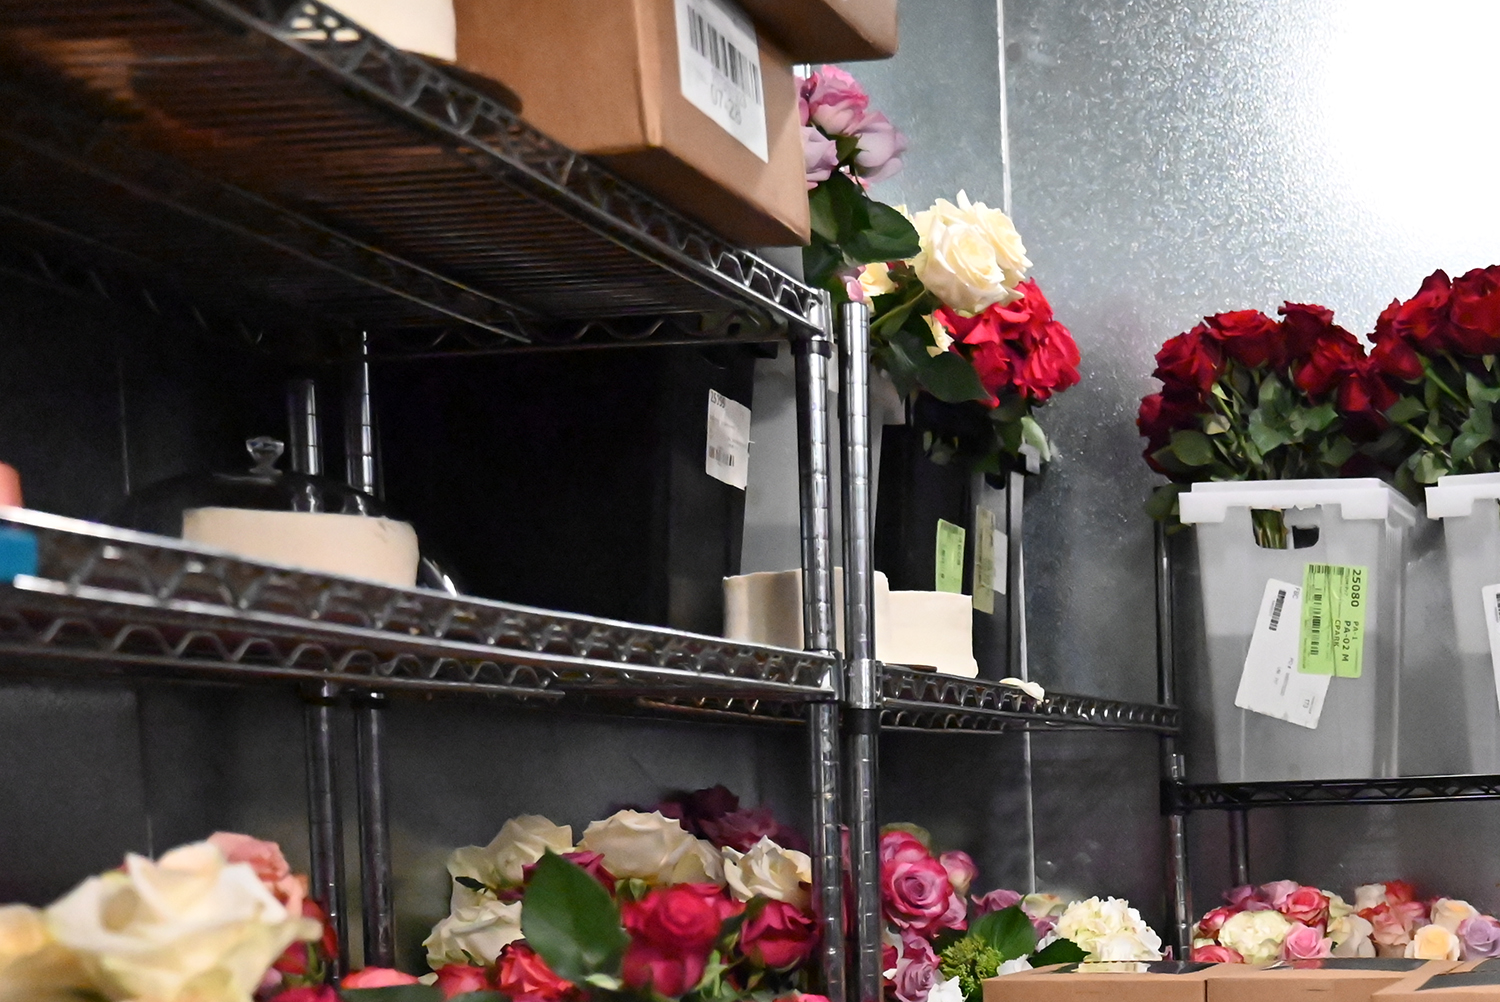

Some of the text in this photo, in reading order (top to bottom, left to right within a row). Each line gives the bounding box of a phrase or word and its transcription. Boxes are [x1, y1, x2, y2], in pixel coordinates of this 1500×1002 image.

[1350, 568, 1362, 608] 25080
[1334, 619, 1342, 648] CPARK
[1342, 620, 1352, 662] PA-02 M
[1352, 620, 1360, 640] PA-1
